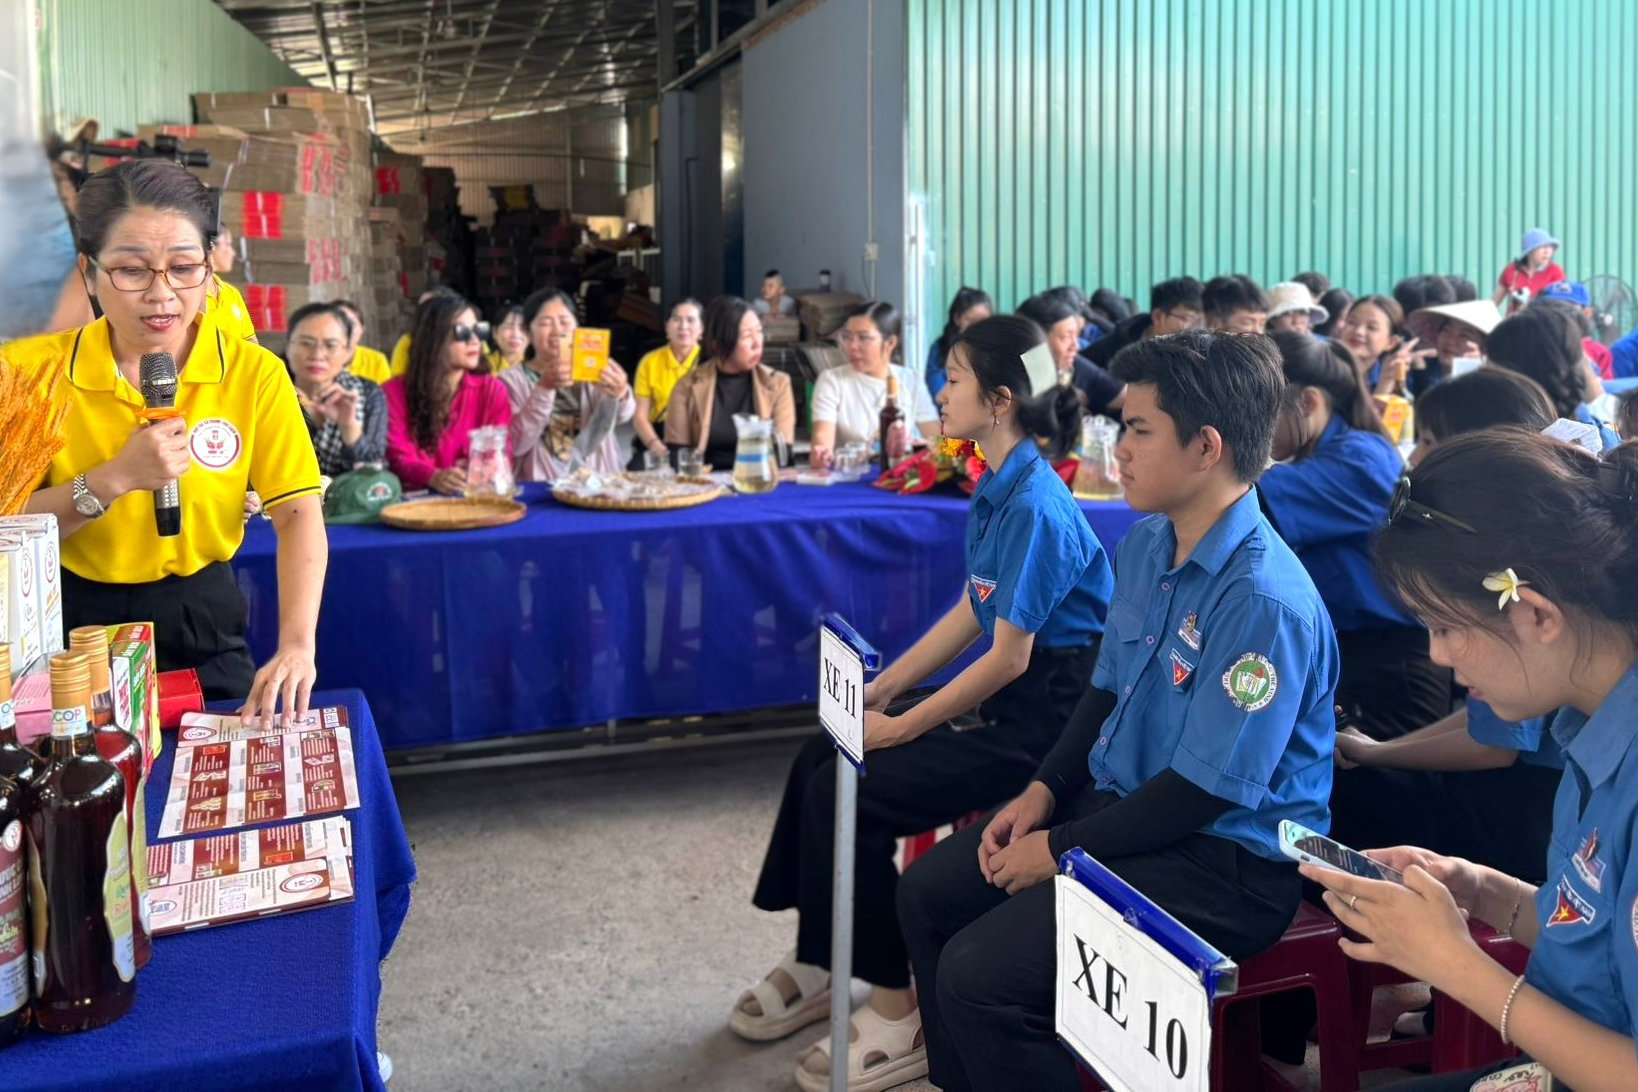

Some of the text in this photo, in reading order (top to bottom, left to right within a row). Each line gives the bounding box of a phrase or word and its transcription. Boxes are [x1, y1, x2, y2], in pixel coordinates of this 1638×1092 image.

[823, 657, 857, 719] XE 11
[1072, 933, 1189, 1080] XE 10
